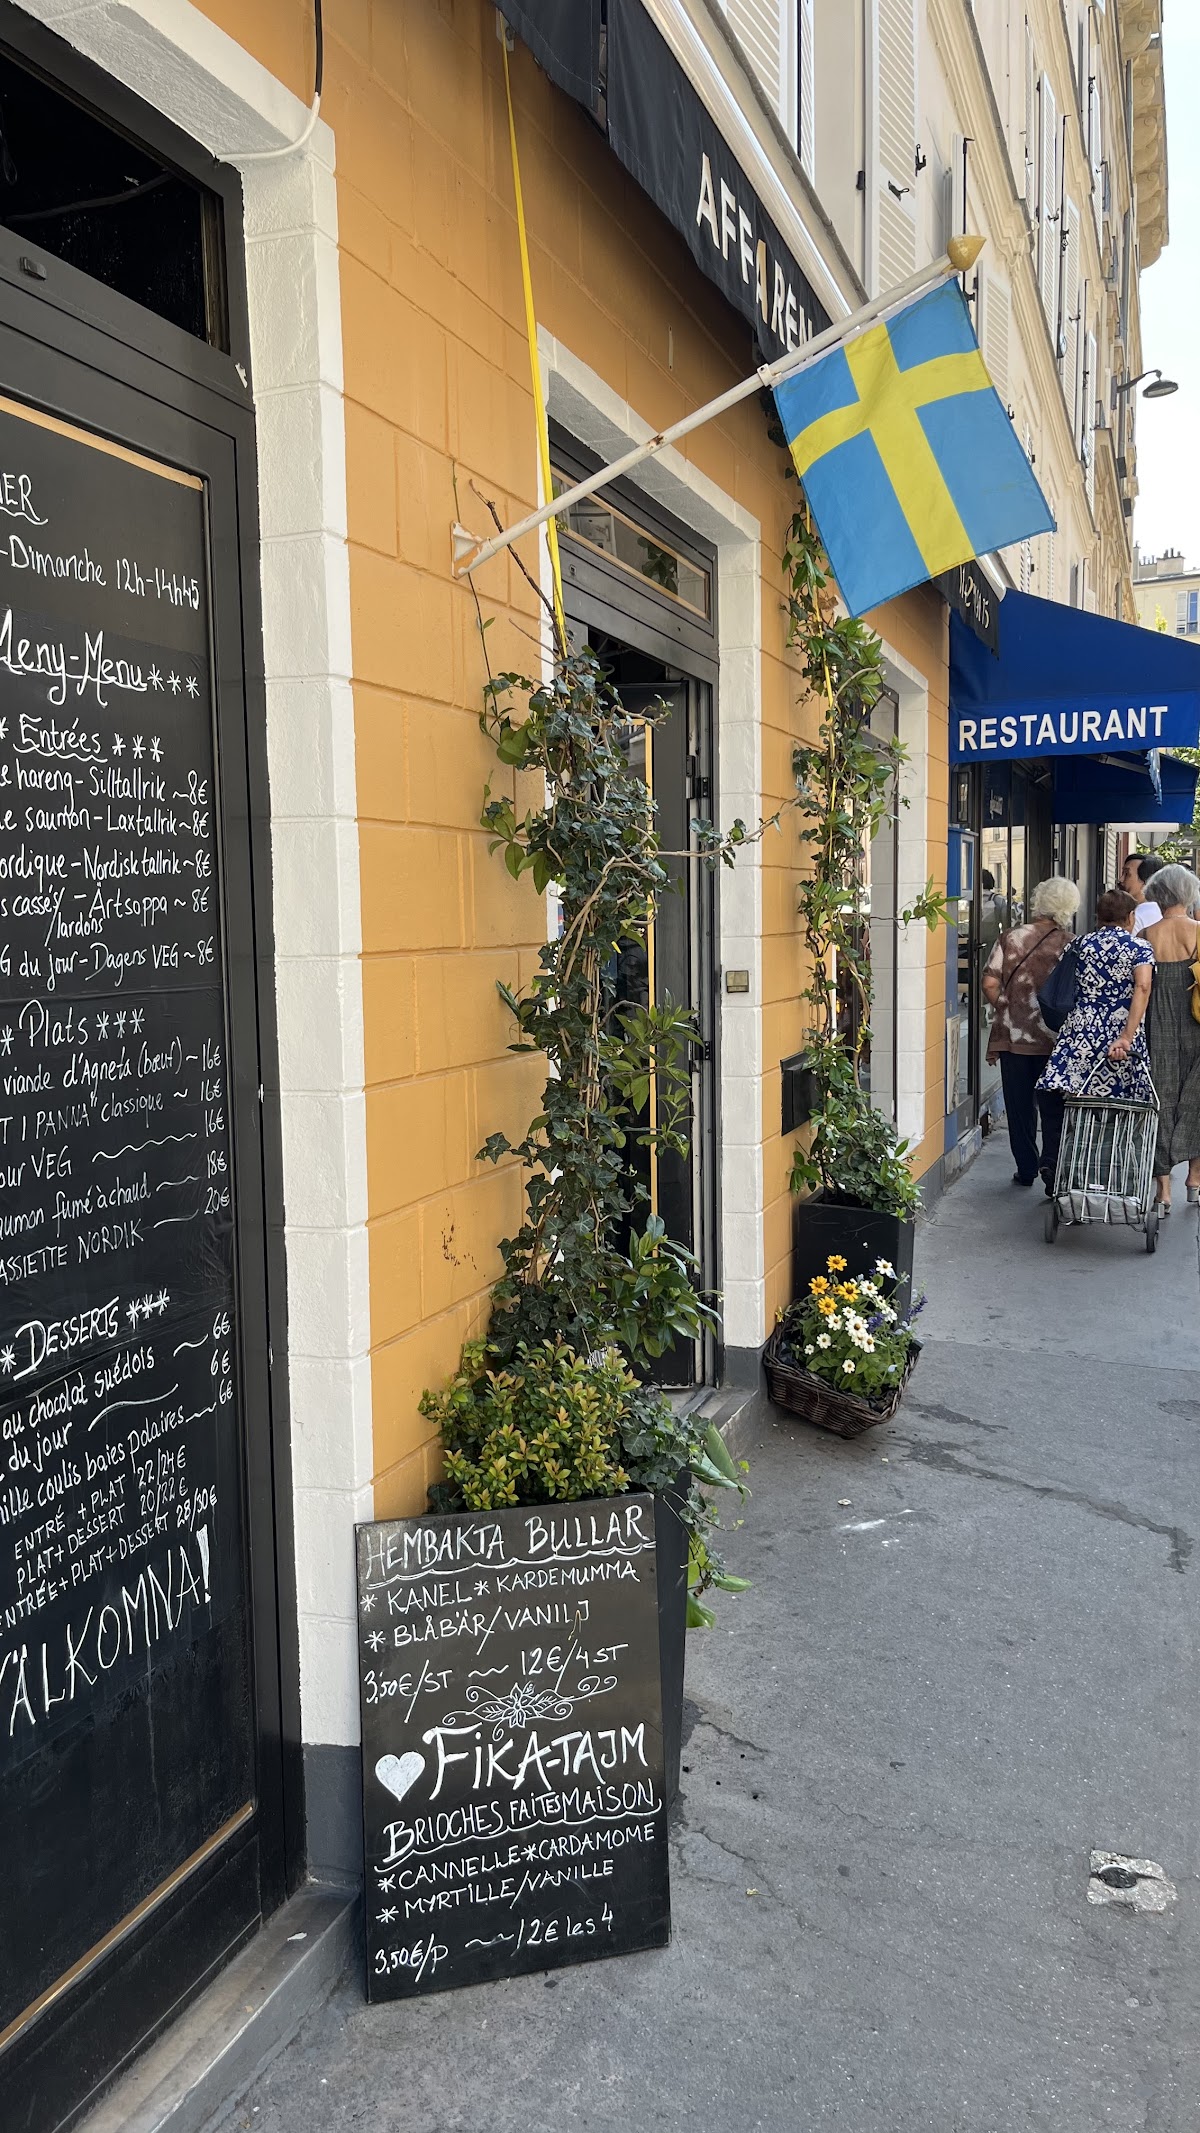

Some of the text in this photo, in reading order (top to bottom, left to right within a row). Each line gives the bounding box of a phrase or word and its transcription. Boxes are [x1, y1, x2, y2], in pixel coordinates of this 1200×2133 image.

[0, 473, 40, 521] ER
[20, 713, 101, 753] Entrées
[959, 706, 1168, 751] RESTAURANT
[25, 804, 91, 832] saumon
[107, 804, 178, 837] Laxtallrik
[19, 951, 42, 977] du
[152, 943, 179, 969] VEG
[19, 1000, 89, 1047] Plats
[4, 1063, 55, 1096] viande
[202, 1038, 222, 1072] 16€
[101, 1088, 164, 1129] classique
[200, 1079, 223, 1102] 16€
[31, 1145, 72, 1180] VEG
[206, 1151, 228, 1178] 18€
[0, 1187, 230, 1286] ASSIETTE NORDIK 20€
[13, 1296, 119, 1381] DESSERTS
[2, 1410, 25, 1440] au
[29, 1372, 89, 1428] chocolat
[94, 1346, 155, 1398] suédois
[8, 1440, 31, 1471] du
[33, 1422, 73, 1473] jour
[37, 1459, 82, 1507] coulis
[85, 1442, 126, 1481] baies
[90, 1474, 126, 1514] PLAT
[365, 1505, 650, 1580] HEMBAKTA BULLAR
[387, 1560, 640, 1614] KANEL KARDEMUMMA
[382, 1801, 502, 1863] BRIOCHES
[566, 1916, 596, 1937] les
[600, 1902, 614, 1932] 4
